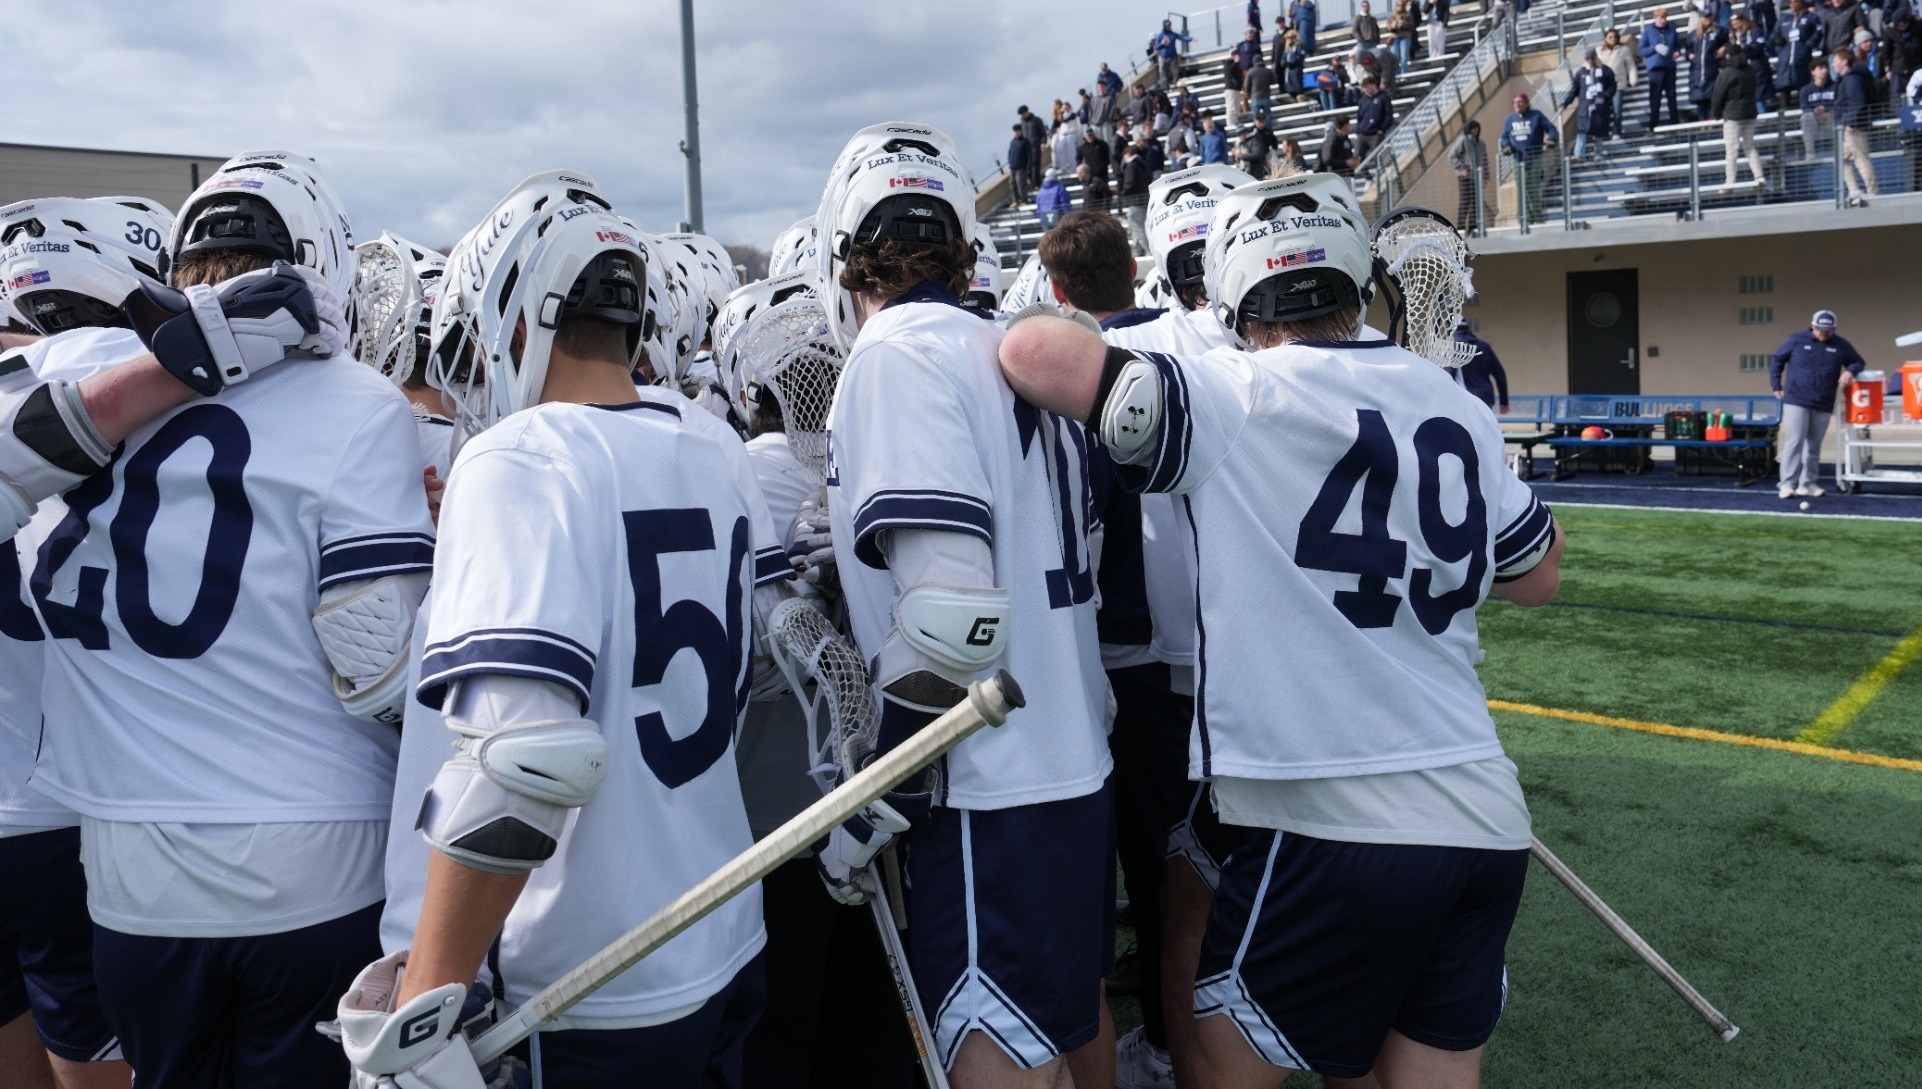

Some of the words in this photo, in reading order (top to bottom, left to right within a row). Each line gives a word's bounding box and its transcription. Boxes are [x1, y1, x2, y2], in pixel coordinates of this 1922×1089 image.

[867, 156, 894, 170] Lux
[896, 153, 914, 163] Et
[915, 154, 959, 179] Veritas
[557, 205, 588, 222] Lux
[1185, 198, 1219, 210] Verit
[124, 220, 162, 252] 30
[1240, 226, 1268, 245] Lux
[1269, 220, 1289, 234] Et
[1290, 214, 1342, 229] Veritas
[21, 241, 70, 254] Veritas
[1852, 389, 1870, 408] G
[1294, 408, 1488, 636] 49
[621, 507, 755, 790] 50
